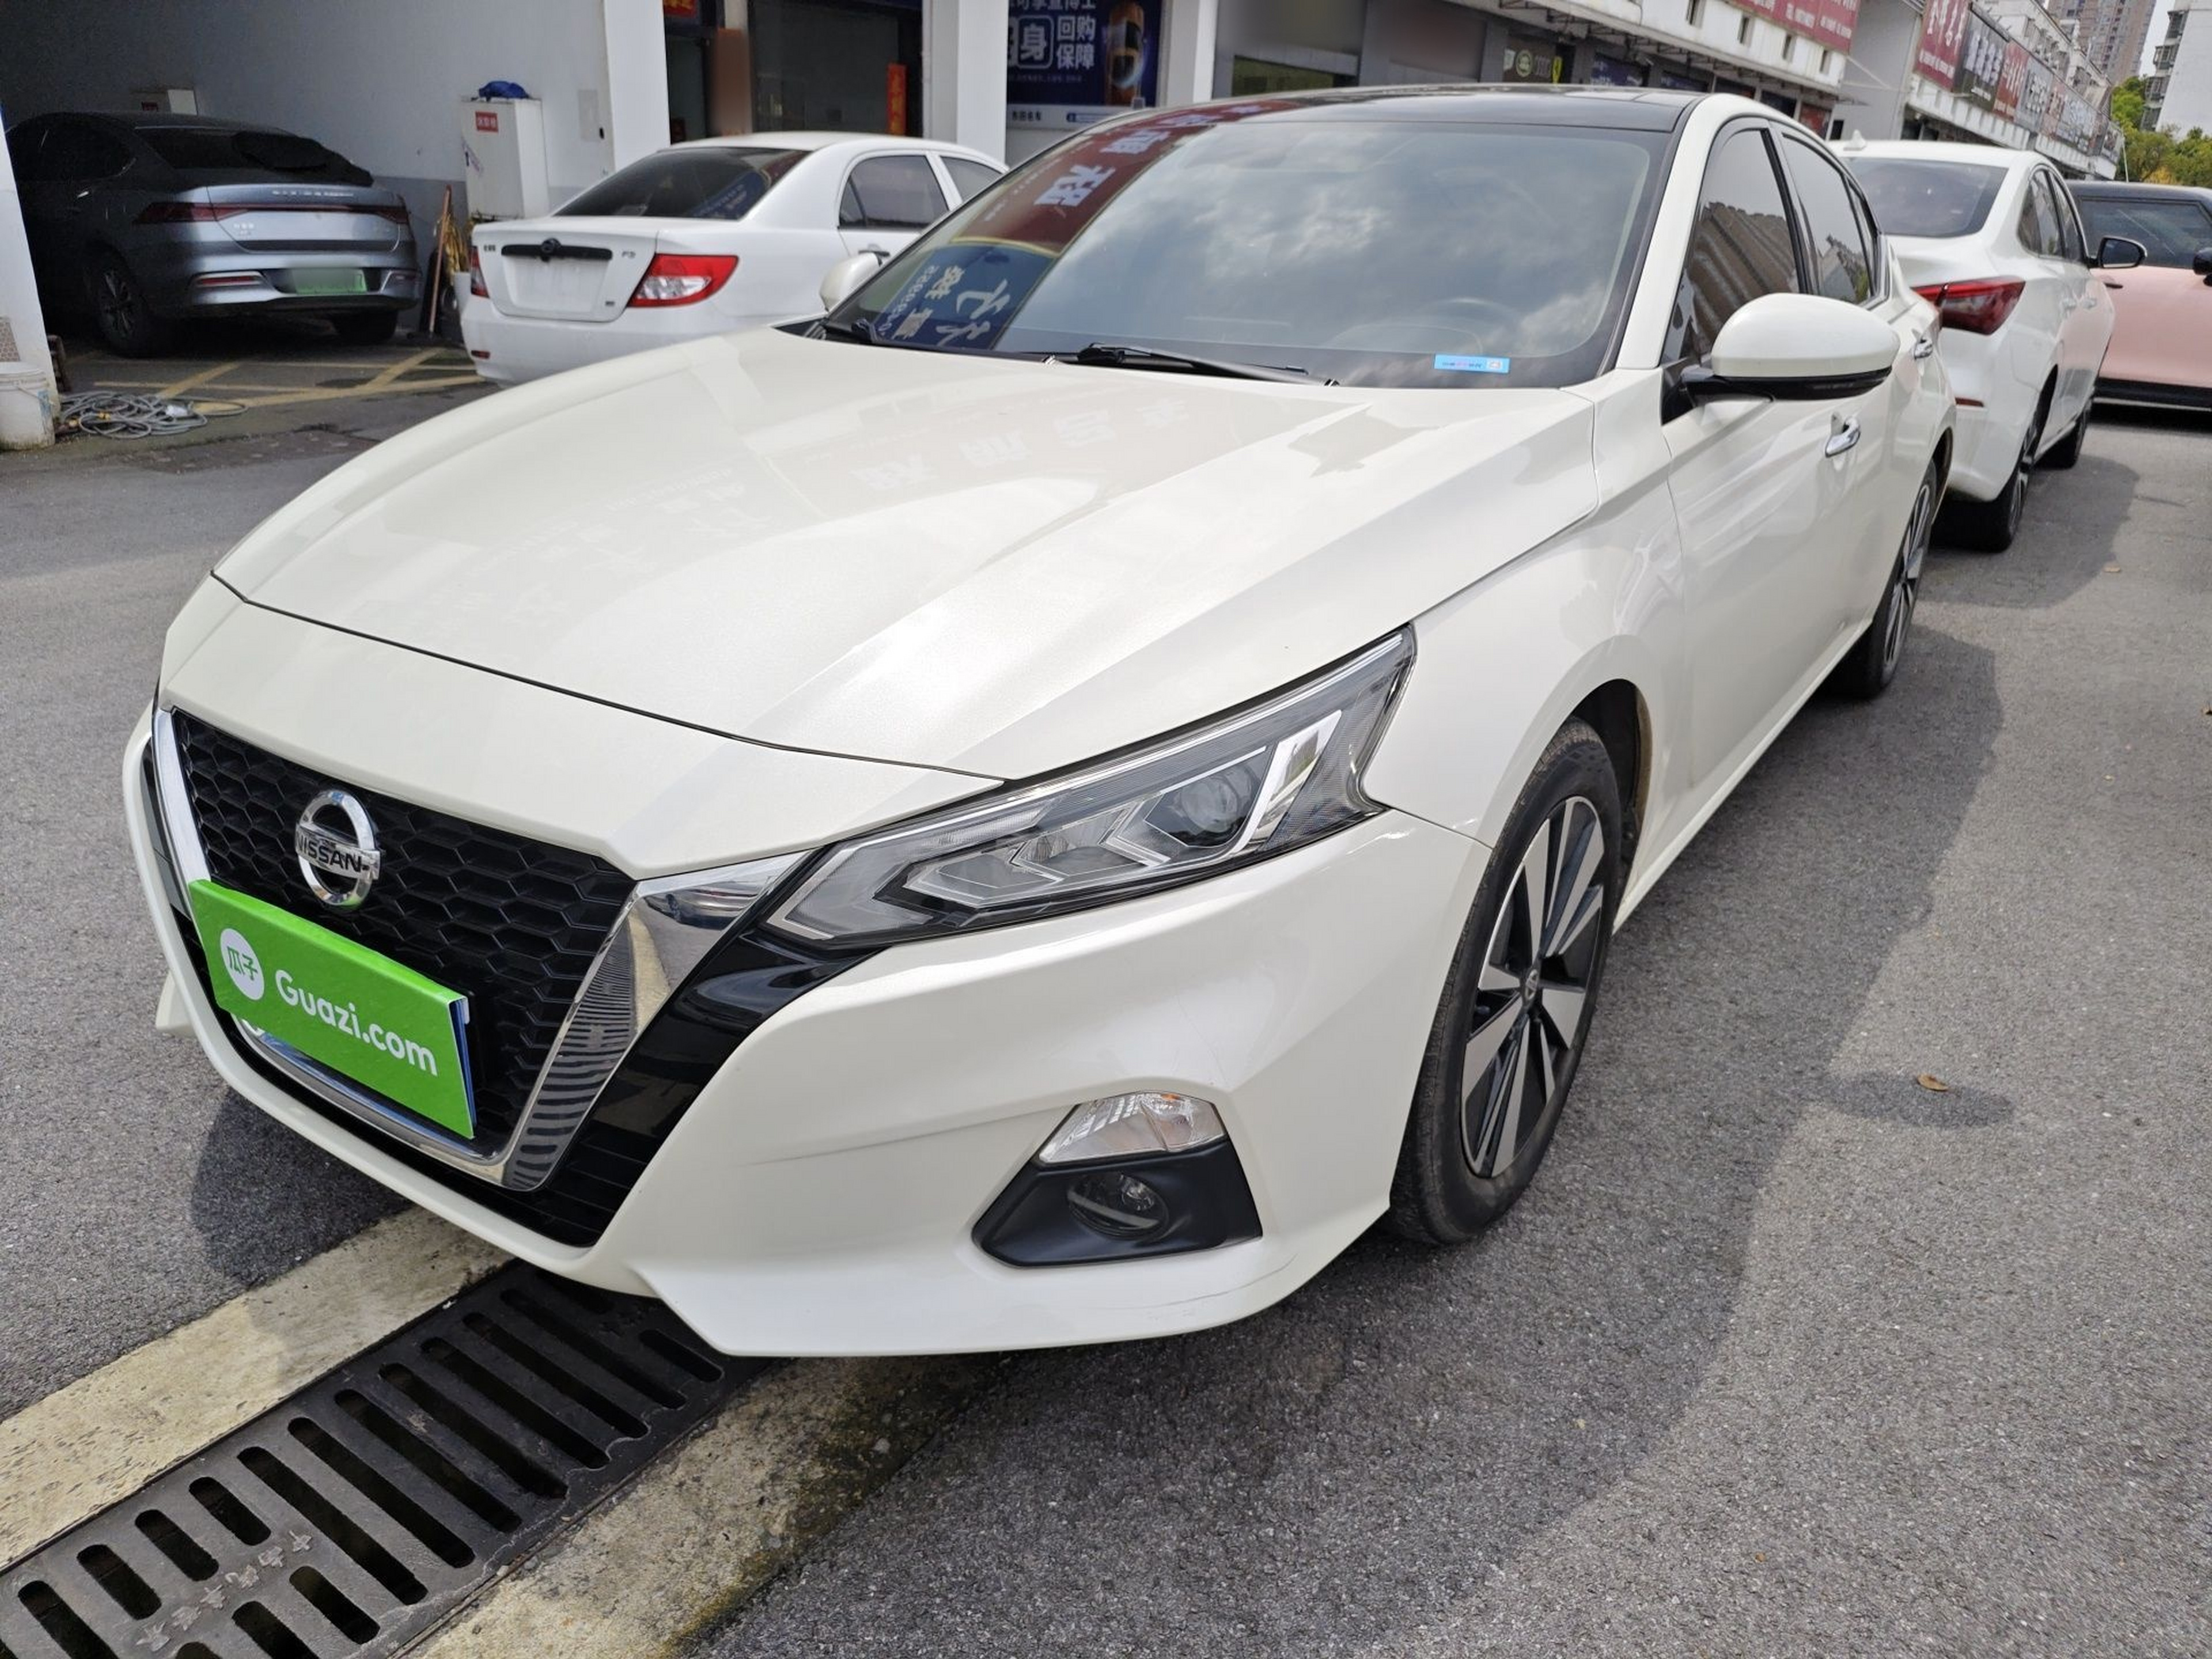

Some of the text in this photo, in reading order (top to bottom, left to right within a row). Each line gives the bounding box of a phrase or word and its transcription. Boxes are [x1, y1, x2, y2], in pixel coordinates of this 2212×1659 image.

[1057, 15, 1096, 41] 回购
[1056, 43, 1094, 70] 保障
[296, 831, 362, 873] NISSAN
[228, 945, 258, 982] 瓜子
[275, 969, 438, 1077] Guazi.com
